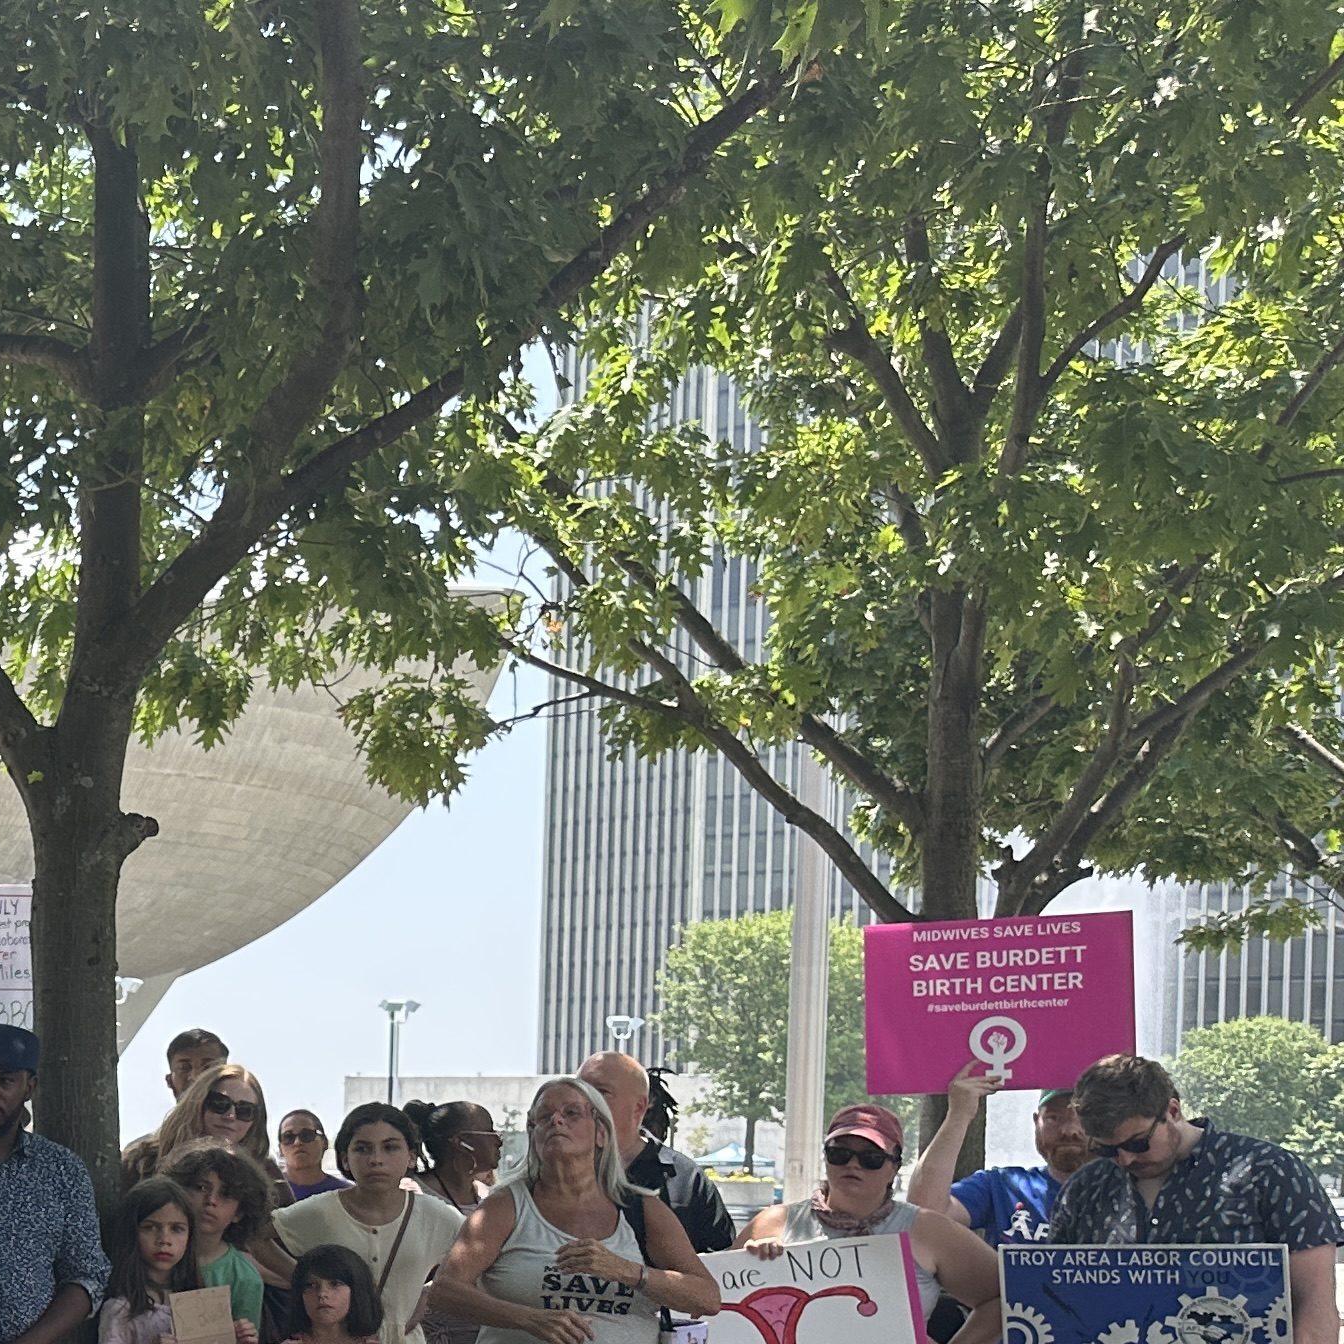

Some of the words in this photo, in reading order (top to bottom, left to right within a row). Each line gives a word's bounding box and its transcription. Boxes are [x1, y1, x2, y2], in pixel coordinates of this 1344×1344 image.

[912, 927, 990, 943] MIDWIVES
[993, 924, 1034, 939] SAVE
[1037, 921, 1081, 936] LIVES
[909, 952, 970, 972] SAVE
[976, 945, 1087, 968] BURDETT
[912, 977, 982, 997] BIRTH
[989, 972, 1084, 994] CENTER
[927, 998, 1070, 1013] #saveburdettbirthcenter
[722, 1268, 766, 1291] are
[786, 1243, 869, 1282] NOT
[1007, 1252, 1057, 1267] TROY
[1062, 1251, 1112, 1267] AREA
[1117, 1251, 1181, 1267] LABOR
[1189, 1250, 1280, 1267] COUNCIL
[542, 1273, 634, 1298] SAVE
[1052, 1269, 1121, 1285] STANDS
[1128, 1269, 1181, 1285] WITH
[1188, 1269, 1231, 1286] YOU
[540, 1295, 632, 1315] LIVES
